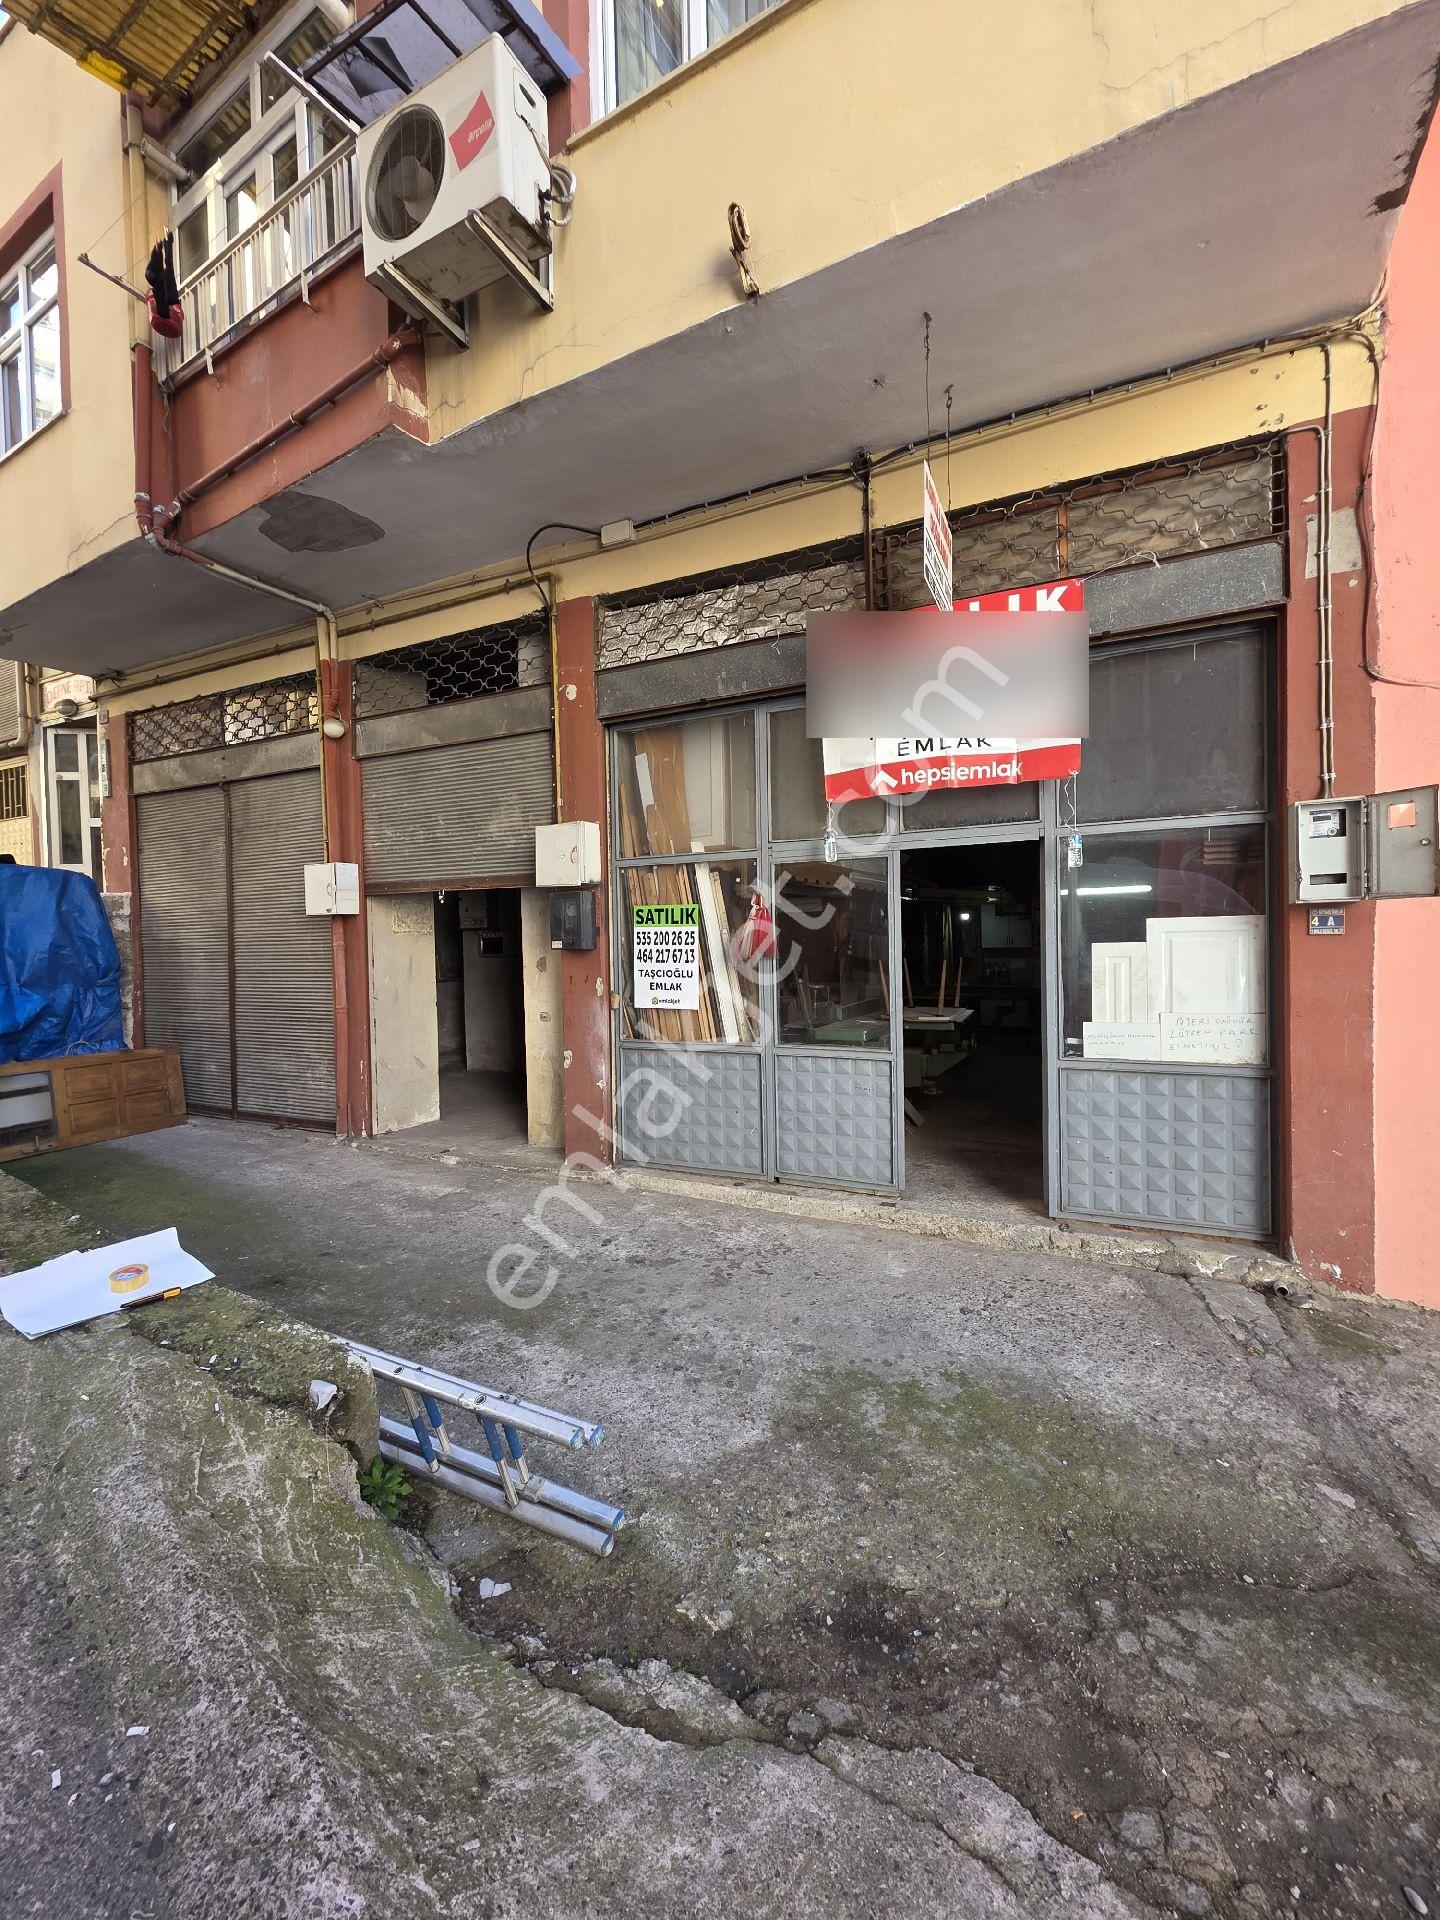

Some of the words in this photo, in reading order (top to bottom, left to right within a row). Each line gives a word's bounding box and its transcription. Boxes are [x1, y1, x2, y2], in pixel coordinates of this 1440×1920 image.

[897, 737, 992, 757] EMLAK
[901, 760, 1024, 786] hepsiemlak
[635, 907, 697, 925] SATILIK
[1311, 916, 1319, 927] 4
[1327, 916, 1335, 927] A
[636, 931, 651, 946] 535
[653, 930, 670, 946] 200
[671, 930, 683, 946] 26
[684, 930, 696, 946] 25
[636, 948, 653, 964] 464
[655, 948, 670, 964] 217
[672, 948, 683, 964] 67
[684, 948, 696, 964] 13
[649, 982, 683, 991] EMLAK
